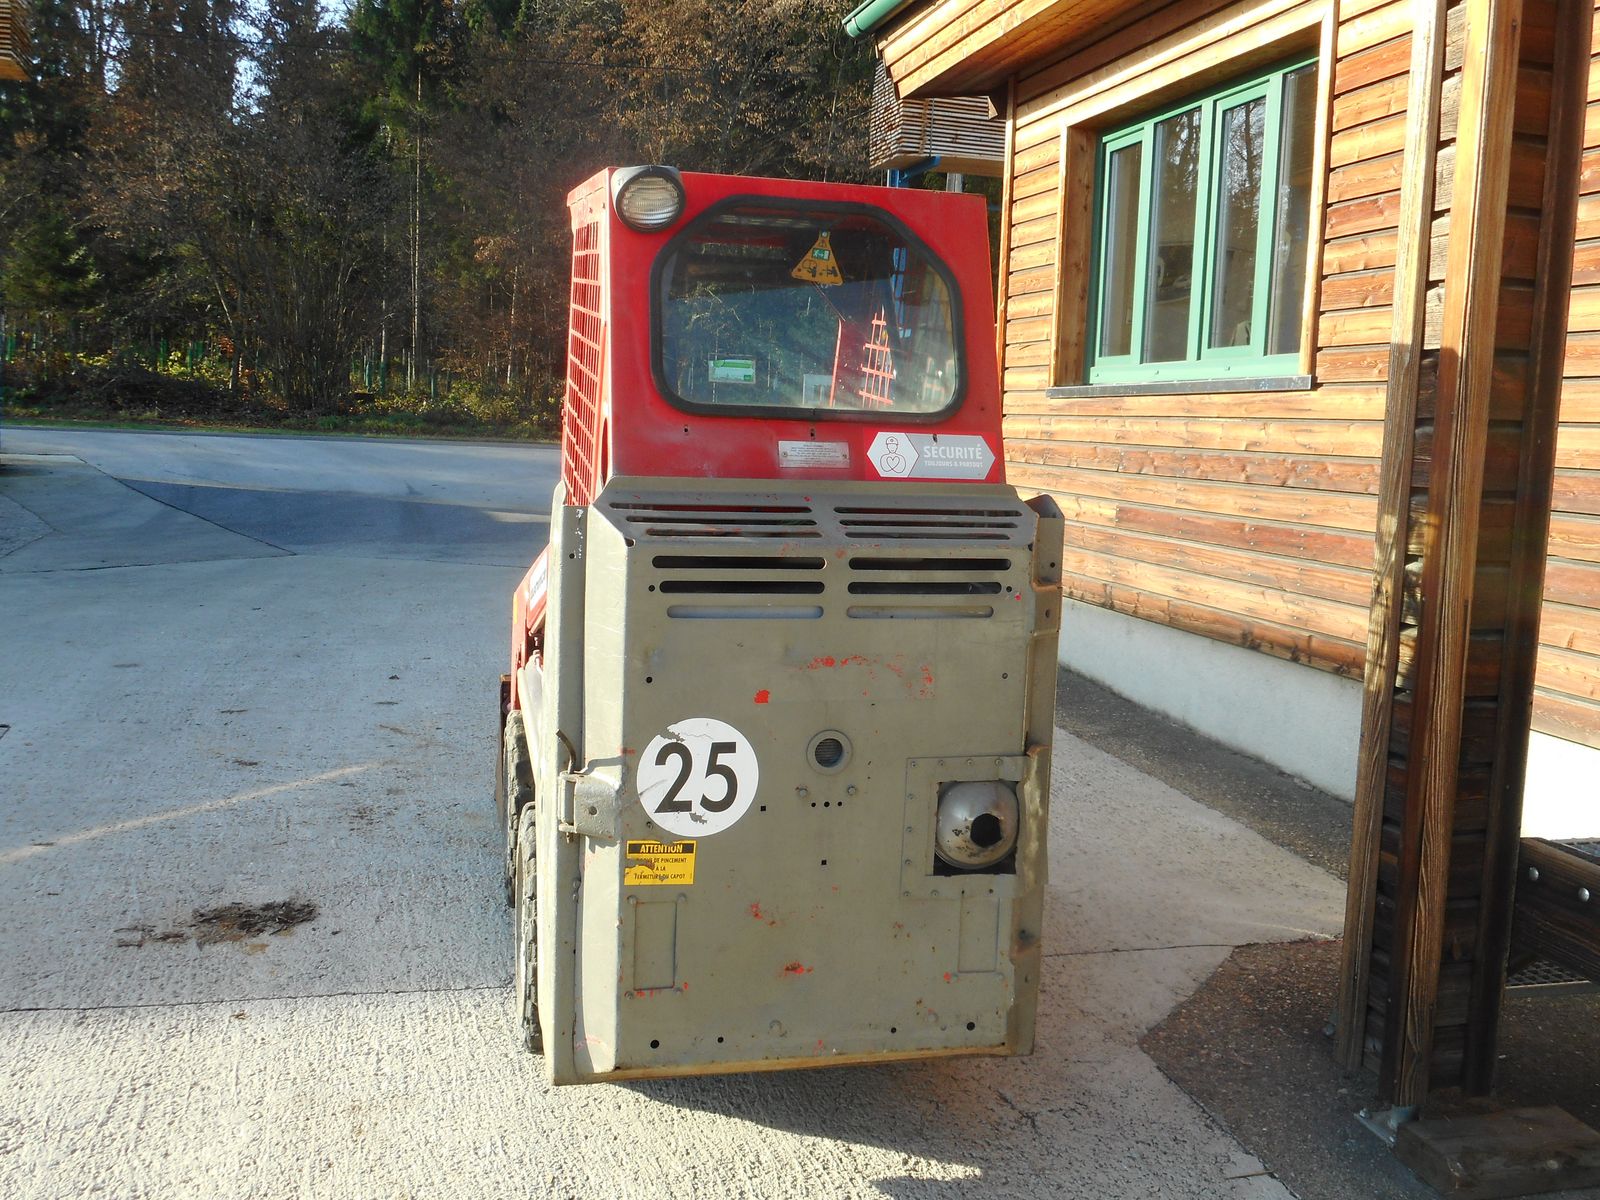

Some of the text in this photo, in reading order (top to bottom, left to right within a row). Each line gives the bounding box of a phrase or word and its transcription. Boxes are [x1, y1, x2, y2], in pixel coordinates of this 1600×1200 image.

[923, 443, 983, 460] SÉCURITÉ
[654, 741, 738, 813] 25
[640, 844, 683, 853] ATTENTION
